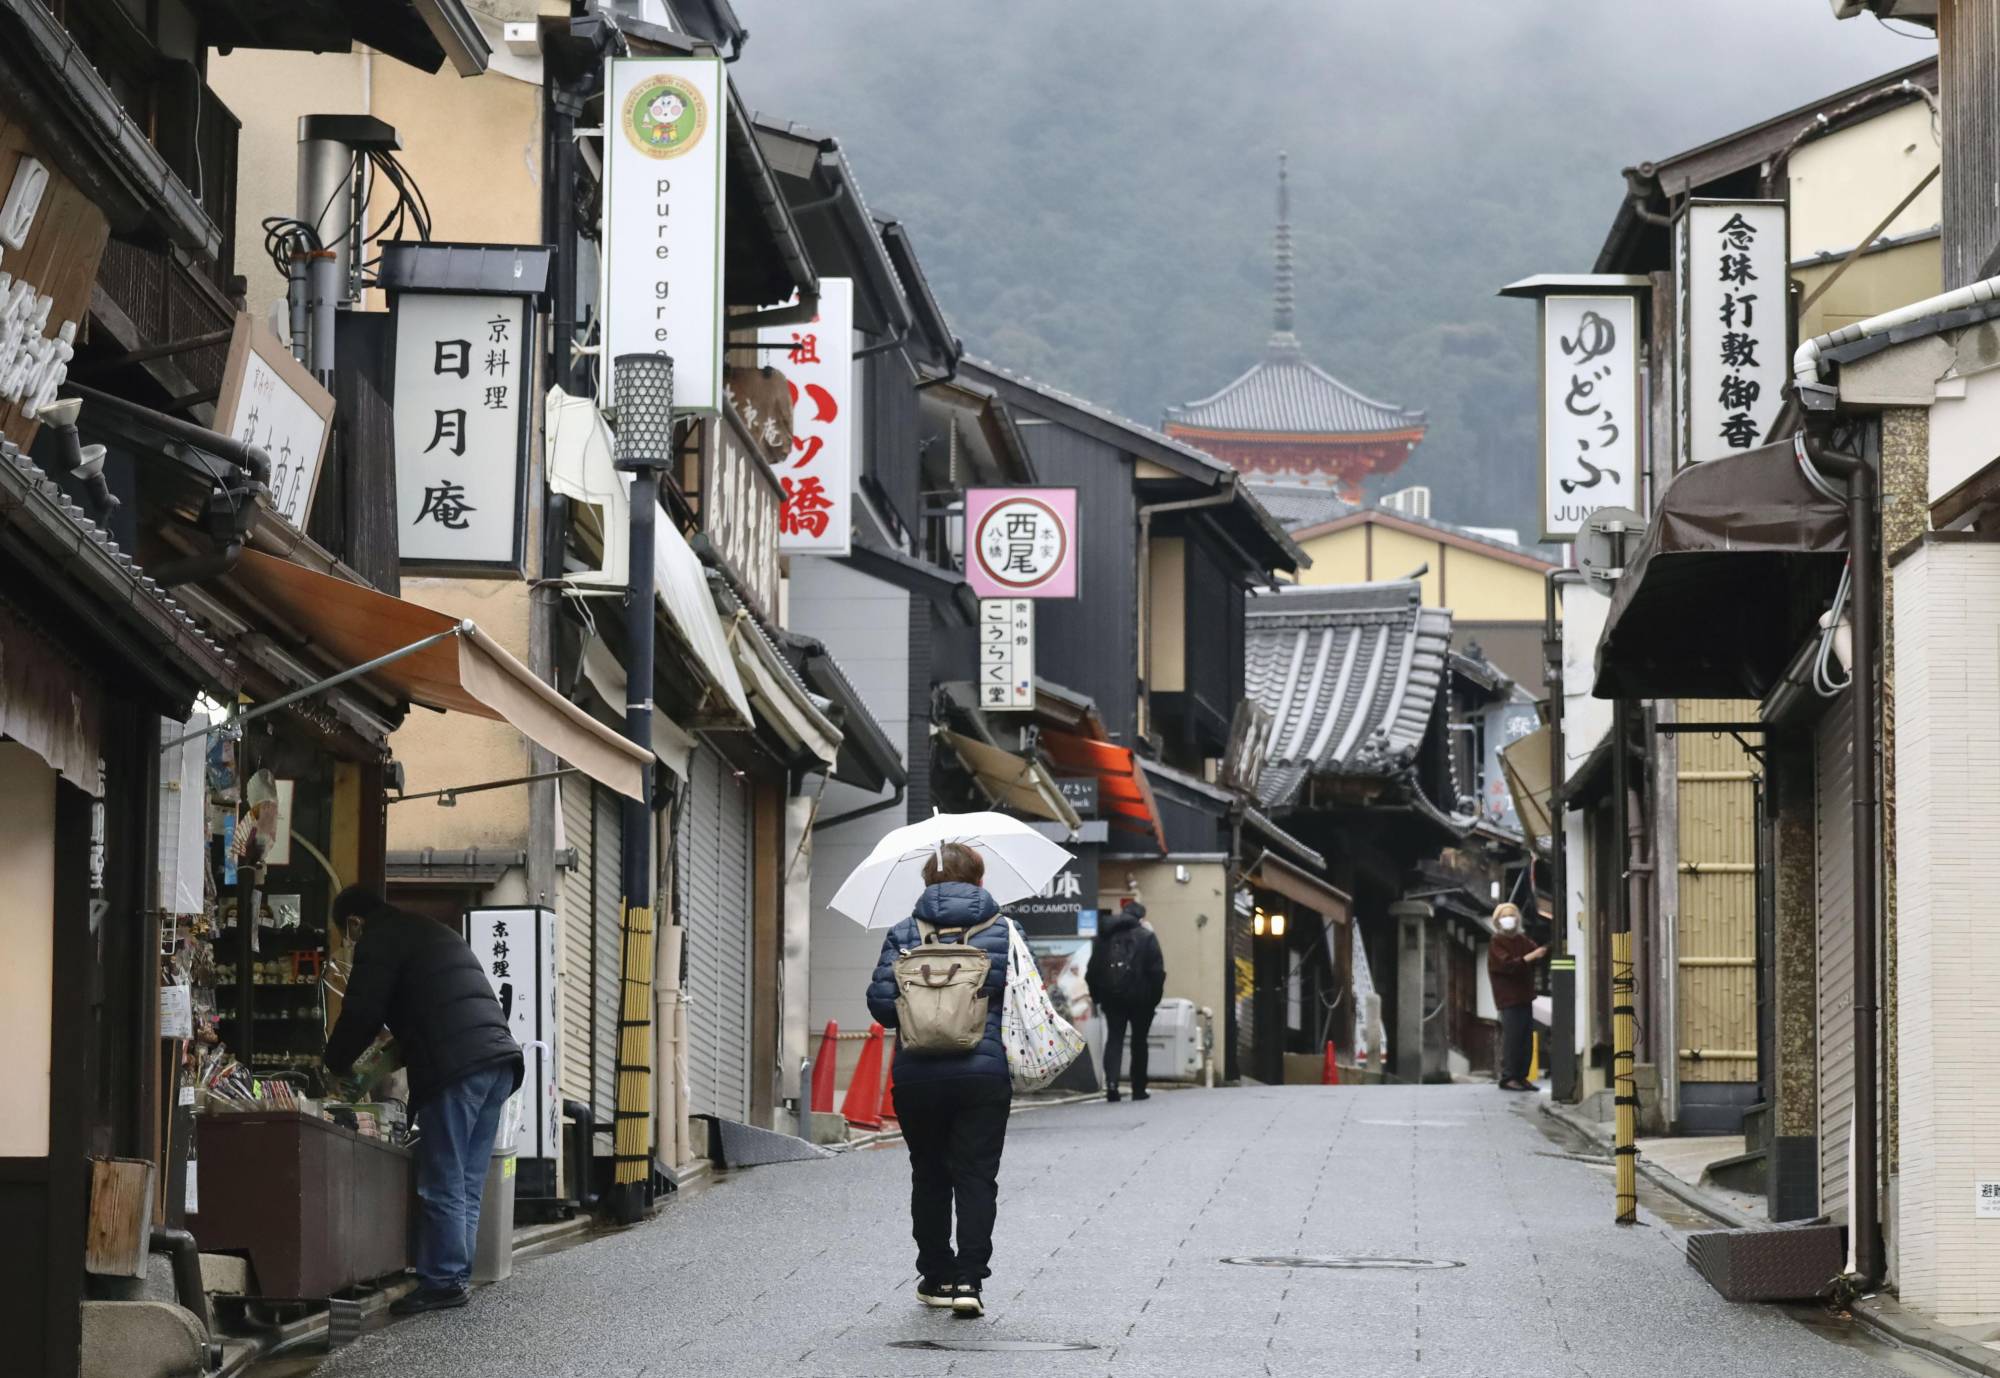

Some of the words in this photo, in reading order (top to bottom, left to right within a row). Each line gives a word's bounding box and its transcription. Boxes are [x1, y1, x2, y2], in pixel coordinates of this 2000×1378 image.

[657, 178, 670, 260] pure
[484, 314, 511, 410] 京料理
[413, 339, 478, 530] 日月庵
[1560, 311, 1621, 494] ゆどうふ
[1001, 513, 1038, 574] 西尾
[1040, 527, 1054, 560] 本家
[988, 604, 1005, 703] こうらく堂
[1032, 903, 1082, 913] OKAMOTO
[1040, 871, 1082, 899] 本
[492, 920, 512, 979] 京料理
